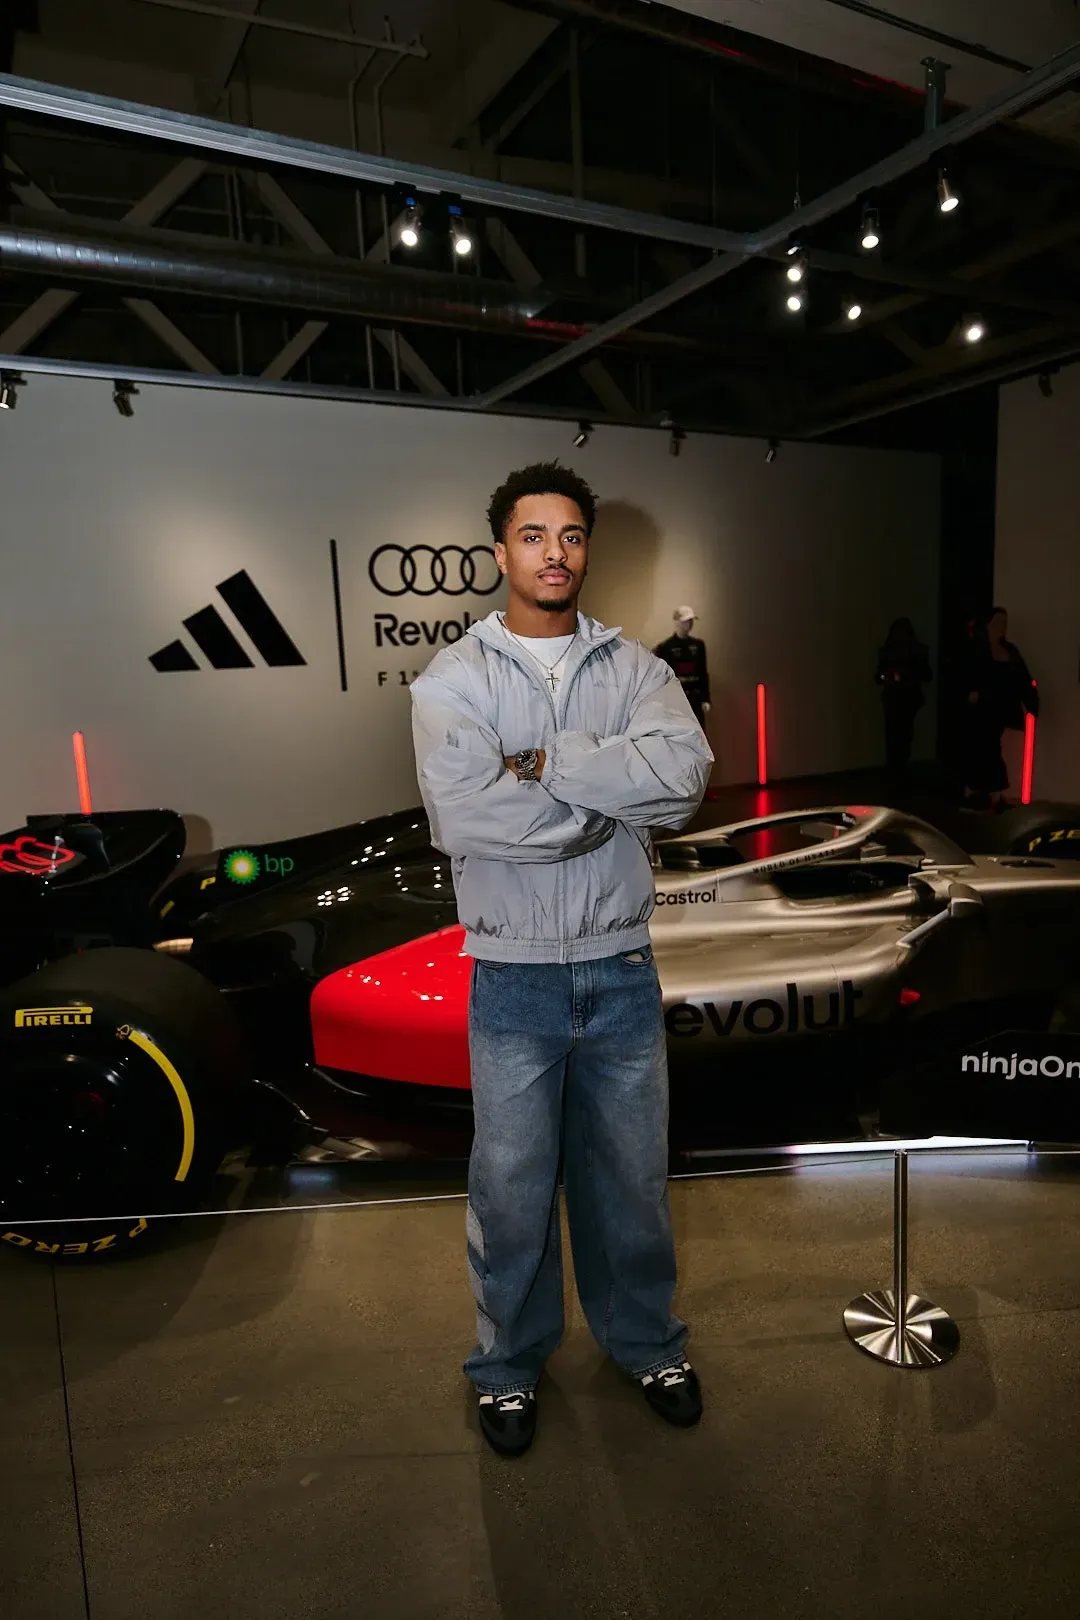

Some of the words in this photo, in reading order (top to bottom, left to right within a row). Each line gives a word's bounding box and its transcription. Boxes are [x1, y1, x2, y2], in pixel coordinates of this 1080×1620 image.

[374, 612, 480, 647] Revol
[264, 854, 295, 876] bp
[655, 889, 716, 906] Castrol
[15, 1006, 93, 1027] PIRELLI
[664, 980, 864, 1037] evolut
[1, 1231, 117, 1254] ZERO
